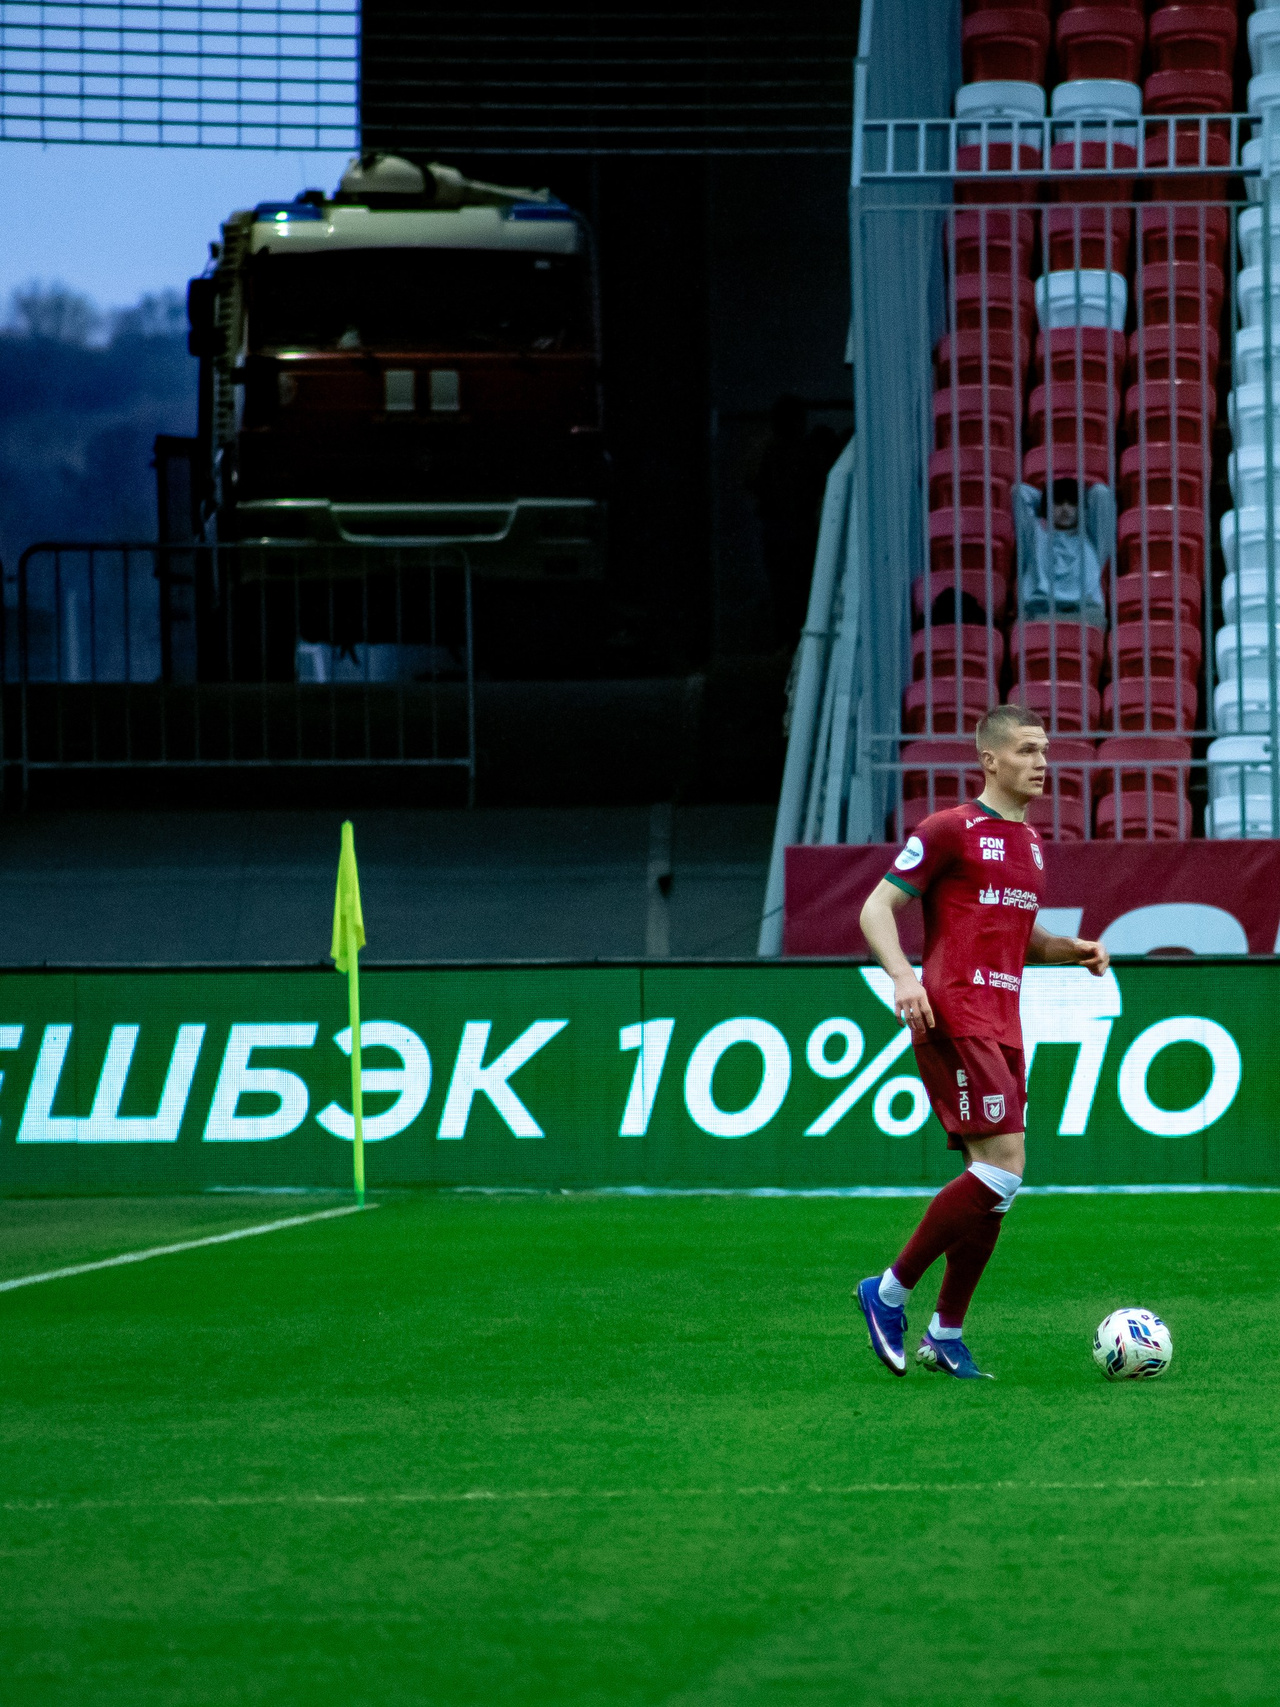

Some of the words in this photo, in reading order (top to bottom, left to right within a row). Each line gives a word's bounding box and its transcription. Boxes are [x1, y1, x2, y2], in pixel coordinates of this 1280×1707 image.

[979, 836, 1004, 850] FON
[982, 848, 1005, 862] BET
[1003, 887, 1038, 902] КАЗАНЬ
[618, 1016, 932, 1138] 10%
